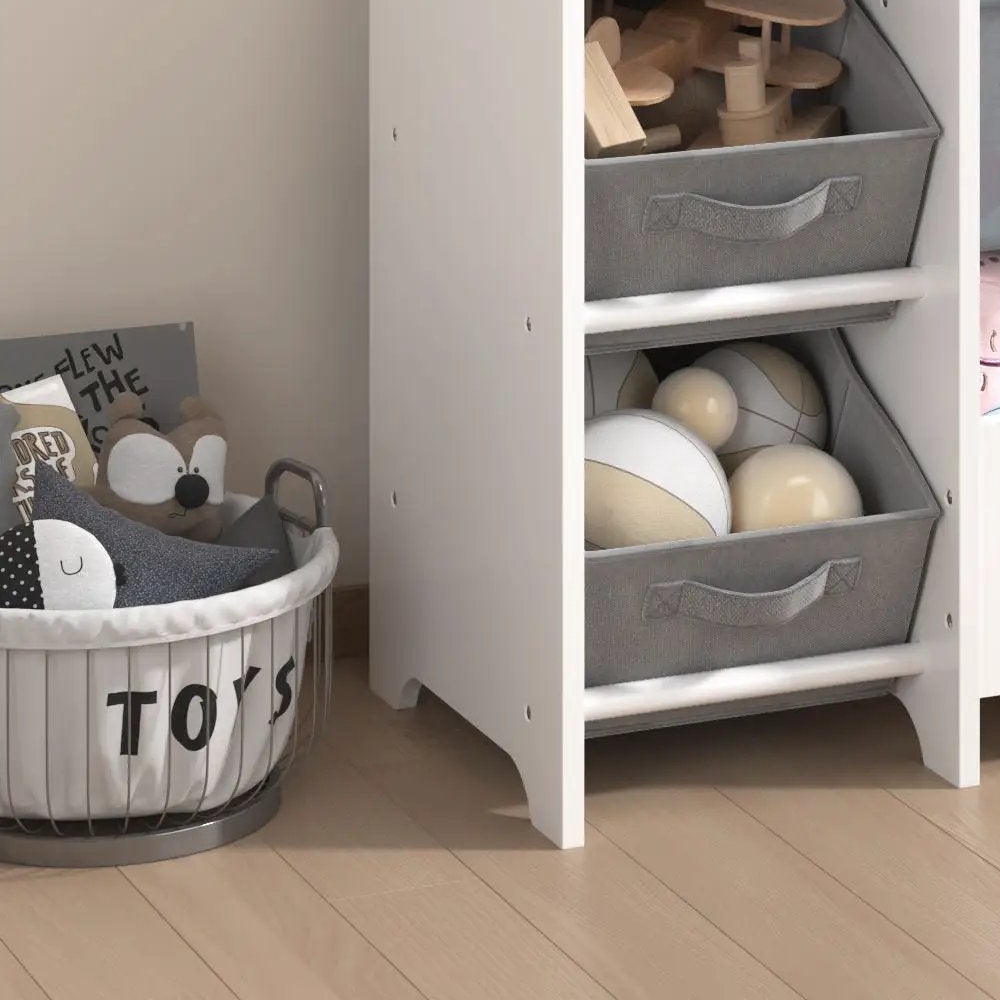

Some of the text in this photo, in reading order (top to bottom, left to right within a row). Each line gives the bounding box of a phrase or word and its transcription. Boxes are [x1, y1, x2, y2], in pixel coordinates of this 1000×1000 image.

[53, 332, 124, 379] FLEW
[79, 367, 149, 412] THE
[10, 430, 70, 466] DRED
[106, 655, 295, 757] TOYS
